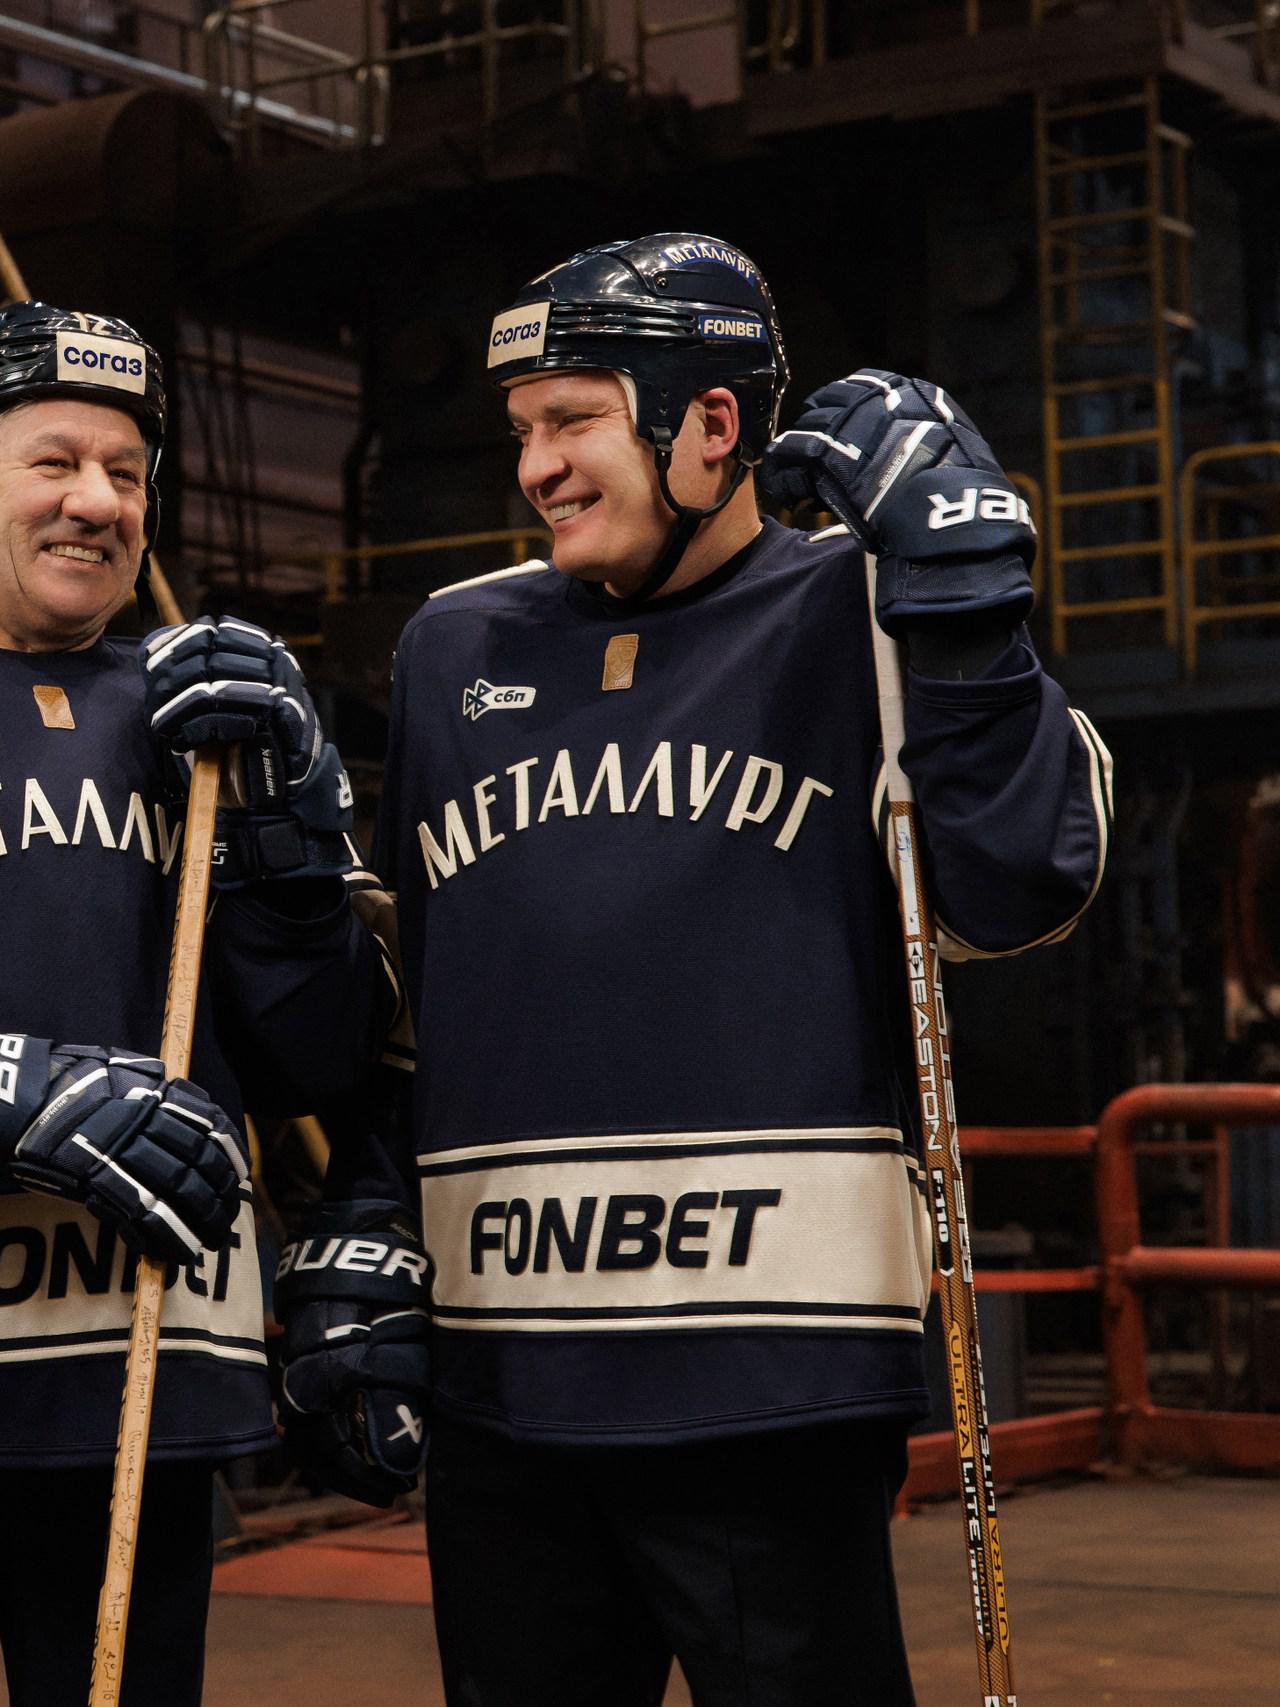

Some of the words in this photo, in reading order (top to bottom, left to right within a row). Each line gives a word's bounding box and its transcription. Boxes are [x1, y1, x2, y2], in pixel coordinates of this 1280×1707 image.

[668, 244, 756, 279] МЕТАЛЛУРГ
[492, 320, 542, 347] согаз
[703, 319, 763, 338] FONBET
[63, 346, 143, 376] согаз
[494, 688, 525, 704] сбп
[417, 741, 834, 890] МЕТАЛЛУРГ
[911, 977, 943, 1151] EASTON
[470, 1188, 782, 1276] FONBET
[950, 1335, 971, 1452] ULTRA
[963, 1461, 982, 1541] LITE
